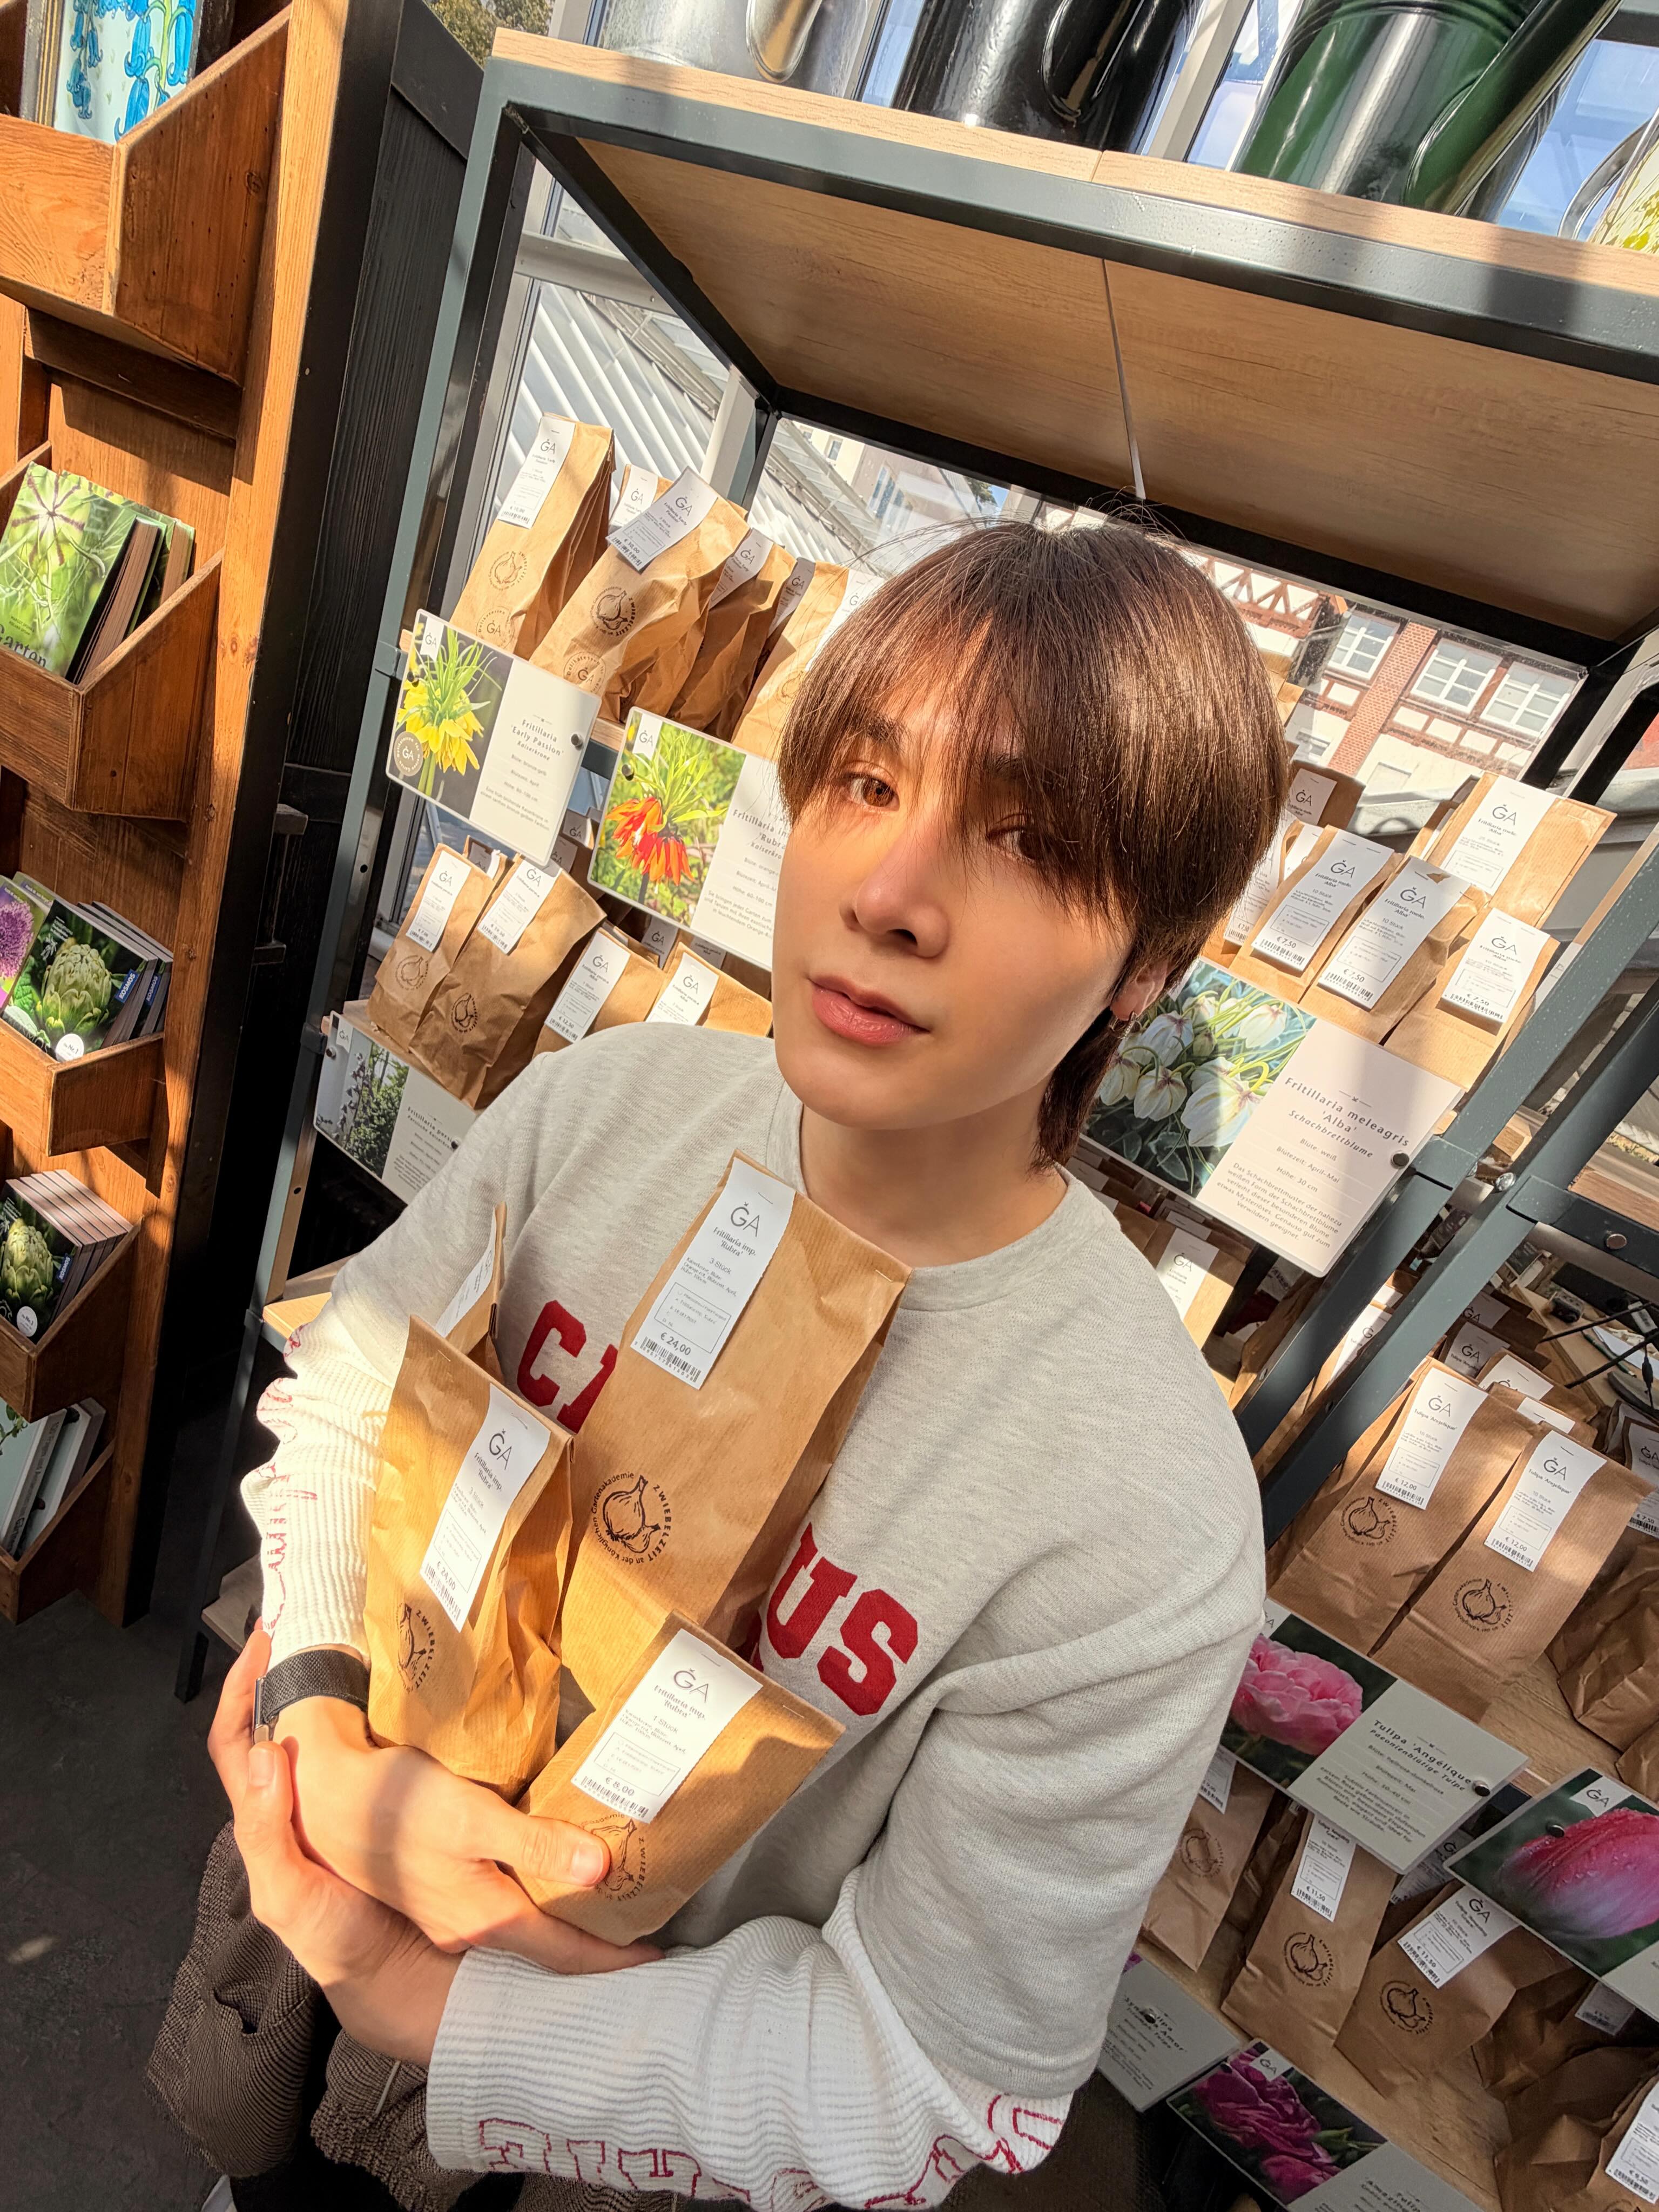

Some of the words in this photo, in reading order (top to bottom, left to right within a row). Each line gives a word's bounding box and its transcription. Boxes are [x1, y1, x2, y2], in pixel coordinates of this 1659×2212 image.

[509, 725, 531, 742] 'Early
[531, 737, 564, 757] Passion'
[521, 719, 558, 743] Fritillaria
[516, 740, 550, 761] Kaiserkrone
[732, 808, 775, 833] Fritillaria
[1478, 817, 1502, 831] Fritillaria
[1314, 872, 1338, 884] Fritillaria
[1384, 898, 1410, 912] Fritillaria
[1281, 938, 1297, 949] 7,50
[119, 973, 135, 999] KOSMOS
[146, 976, 158, 1001] KOSMOS
[1348, 970, 1365, 983] 7,50
[1473, 996, 1490, 1006] 7,50
[562, 1018, 575, 1028] 12,50
[407, 1106, 436, 1130] Fritillaria
[1284, 1076, 1344, 1114] Fritillaria
[1345, 1108, 1411, 1150] meleagris
[1320, 1110, 1357, 1136] 'Alba'
[1288, 1109, 1374, 1159] Schachbrettblume
[1276, 1145, 1307, 1166] Blütezeit:
[1299, 1137, 1320, 1152] Blüte:
[1319, 1148, 1338, 1162] weiß
[1276, 1166, 1297, 1181] Höhe:
[1297, 1177, 1307, 1186] 30
[1306, 1183, 1318, 1193] cm
[1227, 1168, 1251, 1184] weißen
[1250, 1181, 1269, 1195] Form
[1267, 1191, 1280, 1201] der
[1279, 1198, 1340, 1234] Schachbrettblume
[1233, 1162, 1246, 1172] Das
[1245, 1169, 1306, 1206] Schachbrettmuster
[1305, 1202, 1318, 1213] der
[1317, 1209, 1343, 1227] nahezu
[1216, 1181, 1235, 1194] etwas
[1273, 1213, 1303, 1233] Genauso
[1302, 1229, 1316, 1241] gut
[1315, 1237, 1331, 1249] zum
[1226, 1177, 1251, 1194] verleiht
[1250, 1191, 1270, 1205] dieser
[1270, 1202, 1309, 1226] besonderen
[1308, 1223, 1330, 1239] Blume
[1235, 1201, 1270, 1223] Verwildern
[1269, 1220, 1301, 1241] geeignet.
[712, 1226, 743, 1247] Fritillaria
[740, 1243, 758, 1257] imp.
[719, 1239, 744, 1258] 'Rubra'
[59, 1257, 70, 1279] KOSMOS
[659, 1331, 667, 1341] €
[665, 1336, 692, 1357] 24,00
[1413, 1408, 1429, 1419] Tulipa
[473, 1452, 495, 1478] Fritillaria
[490, 1475, 504, 1492] imp.
[476, 1468, 494, 1489] 'Rubra'
[1528, 1468, 1543, 1480] Tulipa
[591, 1471, 634, 1514] Gartenakademie
[1400, 1479, 1417, 1491] 12,00
[648, 1484, 671, 1561] ZWIEBELZEIT
[1510, 1539, 1528, 1552] 12,00
[439, 1567, 457, 1590] 24,00
[415, 1609, 435, 1689] ZWIEBELZEIT
[653, 1684, 690, 1709] Fritillaria
[689, 1704, 707, 1722] imp.
[1373, 1719, 1407, 1745] Tulipa
[1369, 1729, 1439, 1776] Paeonienblütige
[1440, 1773, 1466, 1792] Tulpe
[604, 1776, 612, 1784] €
[611, 1780, 636, 1798] 8,00
[1310, 1889, 1326, 1901] 11,50
[1420, 1951, 1437, 1968] 11,50
